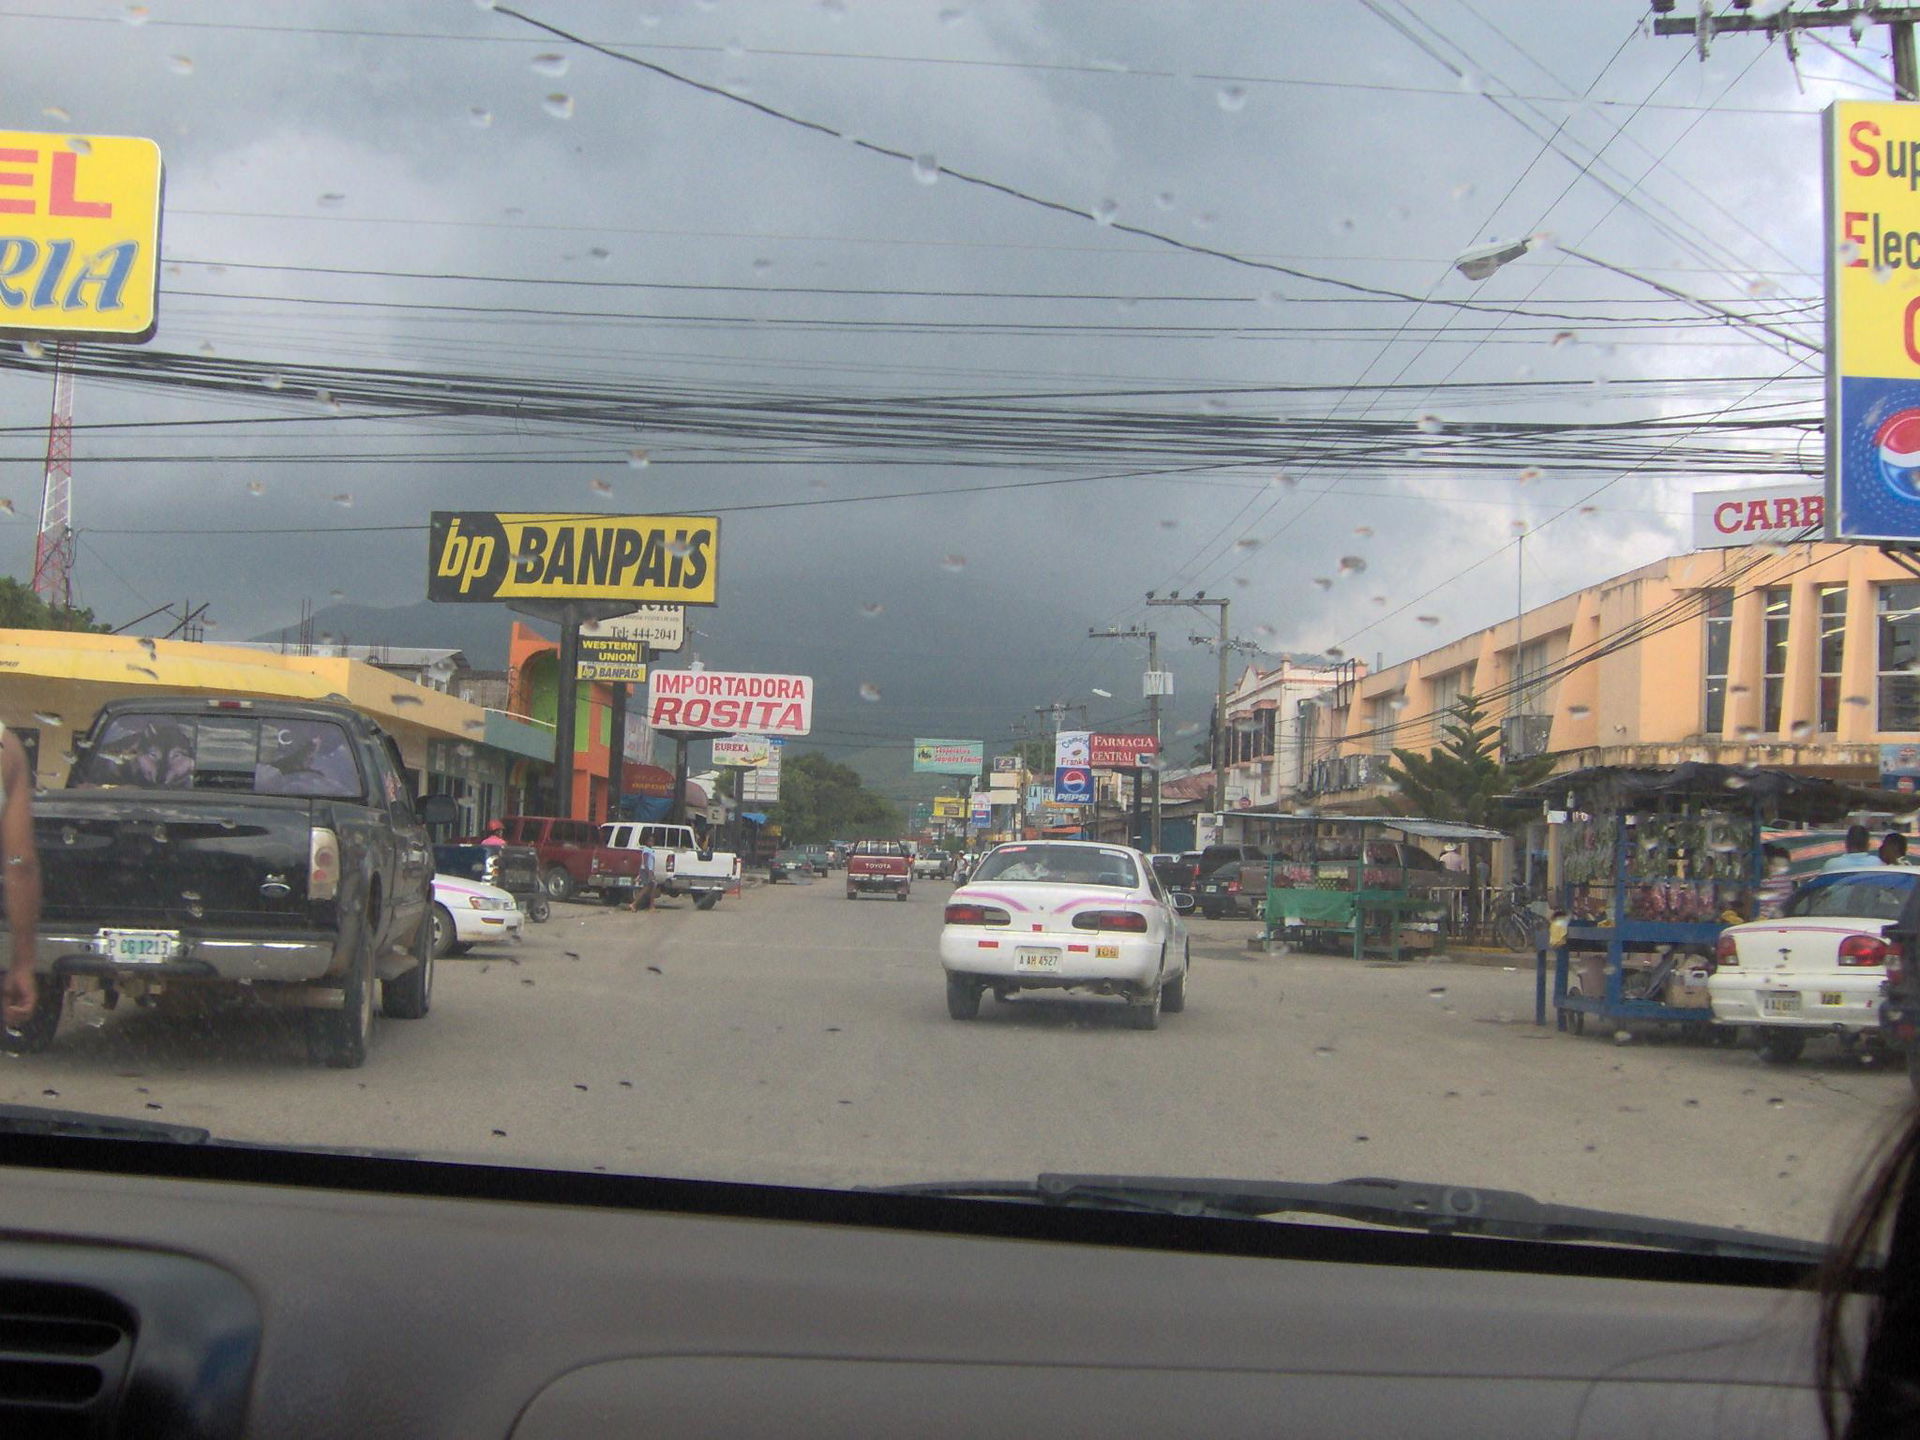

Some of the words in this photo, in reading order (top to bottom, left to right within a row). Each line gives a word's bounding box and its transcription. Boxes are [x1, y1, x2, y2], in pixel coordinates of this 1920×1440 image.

[437, 518, 495, 593] bp
[514, 526, 711, 589] BANPAIS
[632, 627, 677, 641] 444-2041
[582, 640, 636, 651] WESTERN
[598, 652, 636, 662] UNION
[600, 668, 640, 679] BANPAIS
[656, 674, 805, 699] IMPORTADORA
[651, 698, 804, 731] ROSITA
[1094, 736, 1154, 748] FARMACIA
[714, 743, 749, 753] EUREKA
[1092, 751, 1134, 762] CENTRAL
[1057, 794, 1090, 803] PEPSI
[865, 862, 892, 870] TOYOTA
